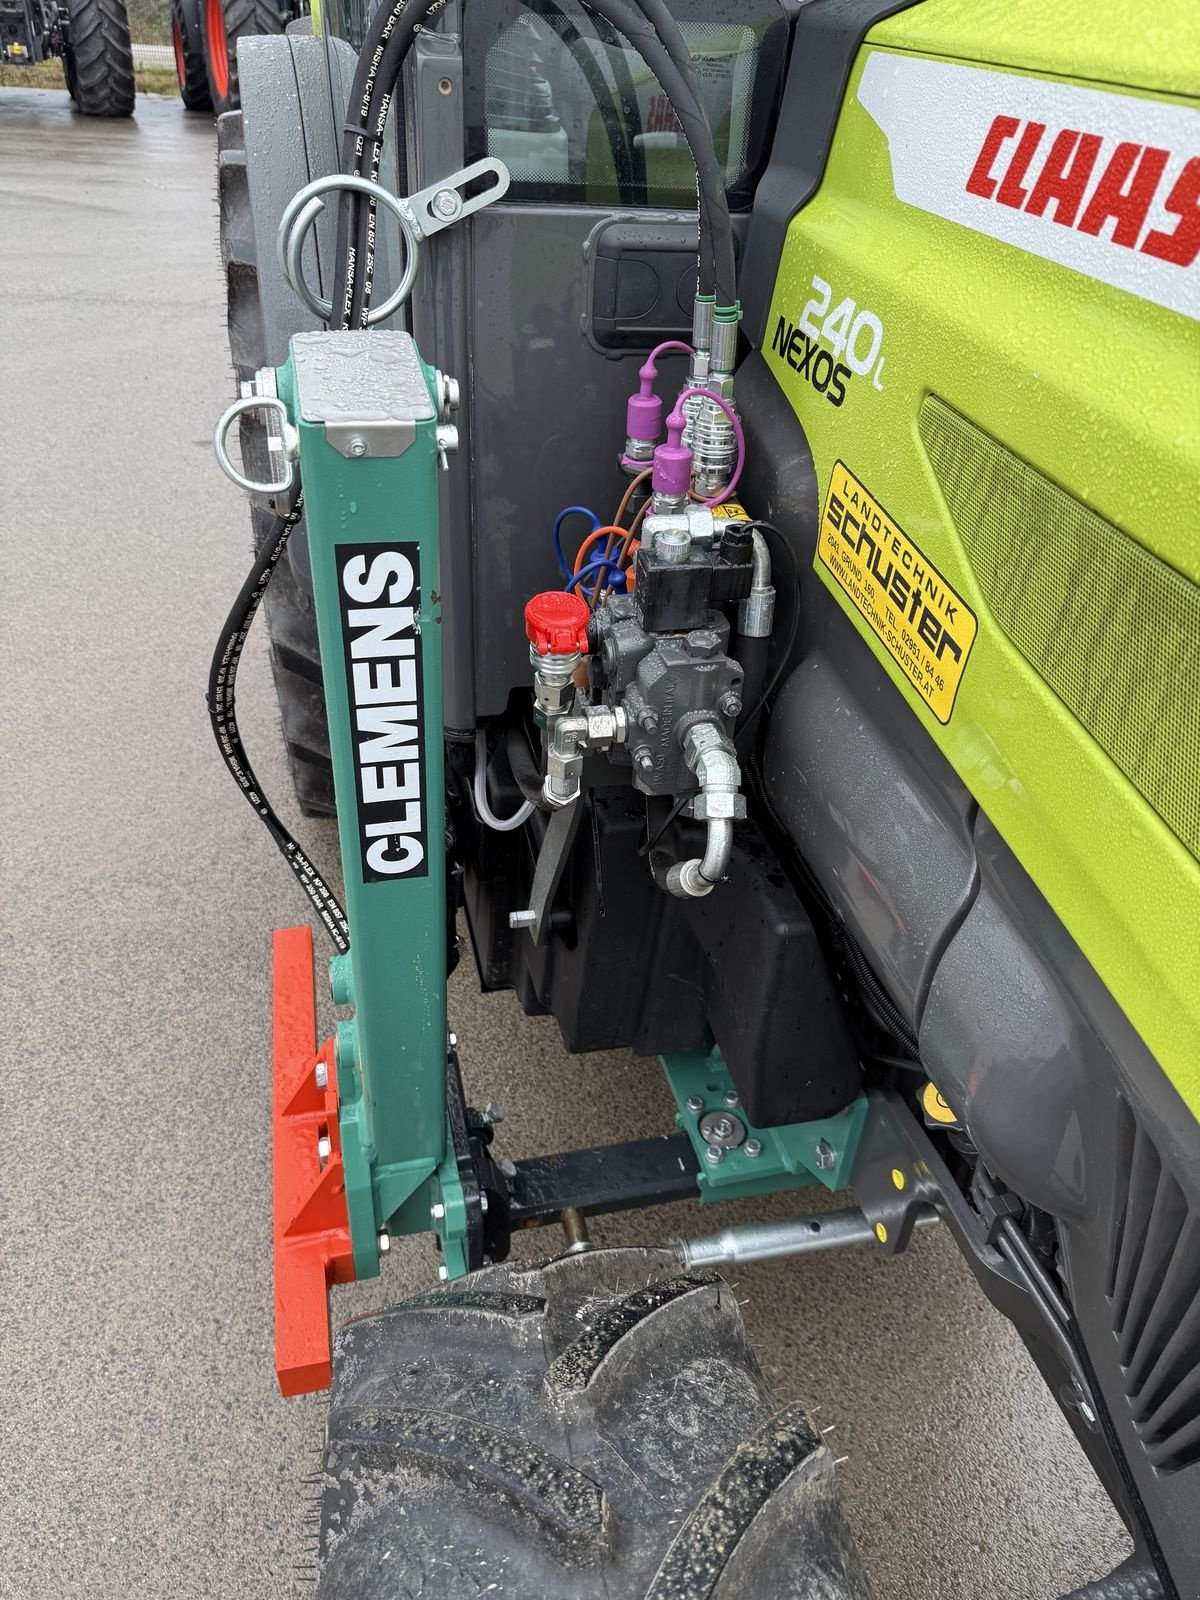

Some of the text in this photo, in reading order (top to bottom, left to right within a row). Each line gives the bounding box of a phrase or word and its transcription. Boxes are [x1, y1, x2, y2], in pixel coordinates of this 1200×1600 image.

[381, 15, 397, 39] BAR
[368, 45, 384, 77] MSHA
[360, 79, 374, 117] IC-8/19
[368, 213, 375, 230] EN
[966, 115, 1200, 267] CLAAS
[343, 247, 356, 315] HANSA-FLEX
[366, 252, 374, 274] 2SC
[799, 274, 883, 376] 240
[772, 315, 852, 407] NEXOS
[842, 480, 958, 625] LANDTECHNIK
[827, 533, 839, 554] 2041
[841, 551, 862, 581] GRUND
[885, 605, 899, 632] TEL.
[901, 629, 920, 661] 02951
[924, 661, 934, 678] 84
[935, 675, 945, 691] 46
[829, 552, 935, 698] WWW.LANDTECHNIK-SCHUSTER.AT
[343, 551, 424, 874] CLEMENS
[223, 742, 233, 755] BAR
[312, 894, 324, 909] BAR
[321, 910, 334, 930] MSHA
[331, 926, 347, 949] IC-8/19
[326, 898, 337, 910] EN
